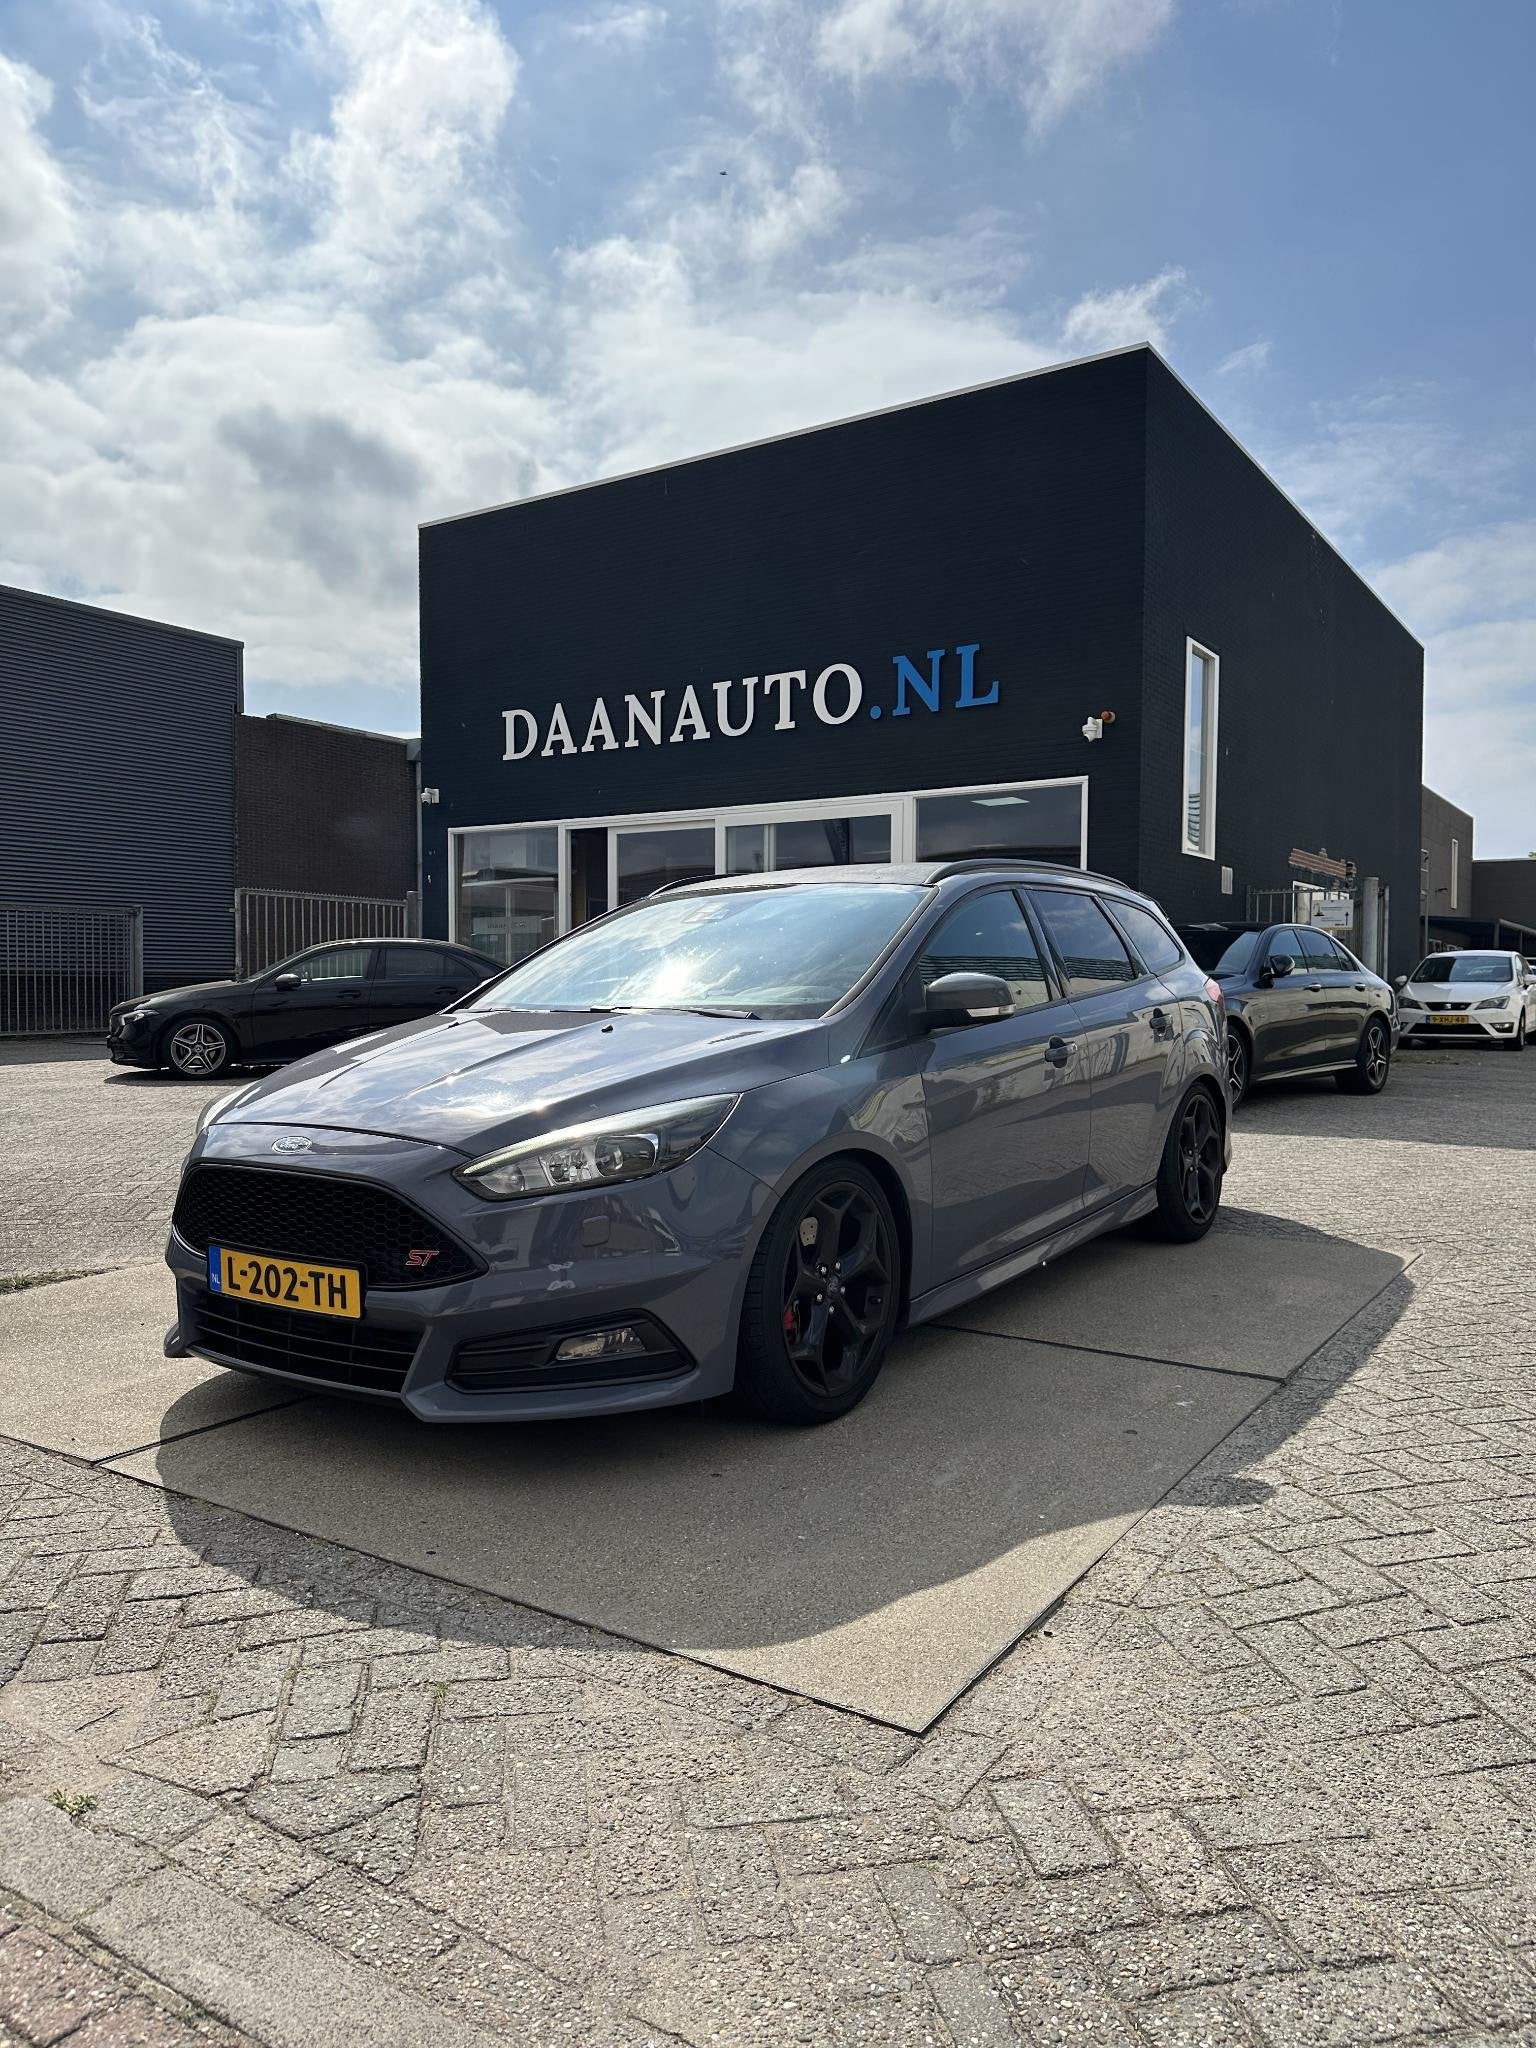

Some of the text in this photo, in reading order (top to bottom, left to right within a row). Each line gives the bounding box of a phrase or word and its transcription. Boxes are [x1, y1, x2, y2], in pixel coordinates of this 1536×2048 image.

[502, 643, 999, 761] DAANAUTO.NL
[405, 1250, 440, 1266] ST
[211, 1272, 221, 1285] NL
[227, 1256, 347, 1309] L-202-TH
